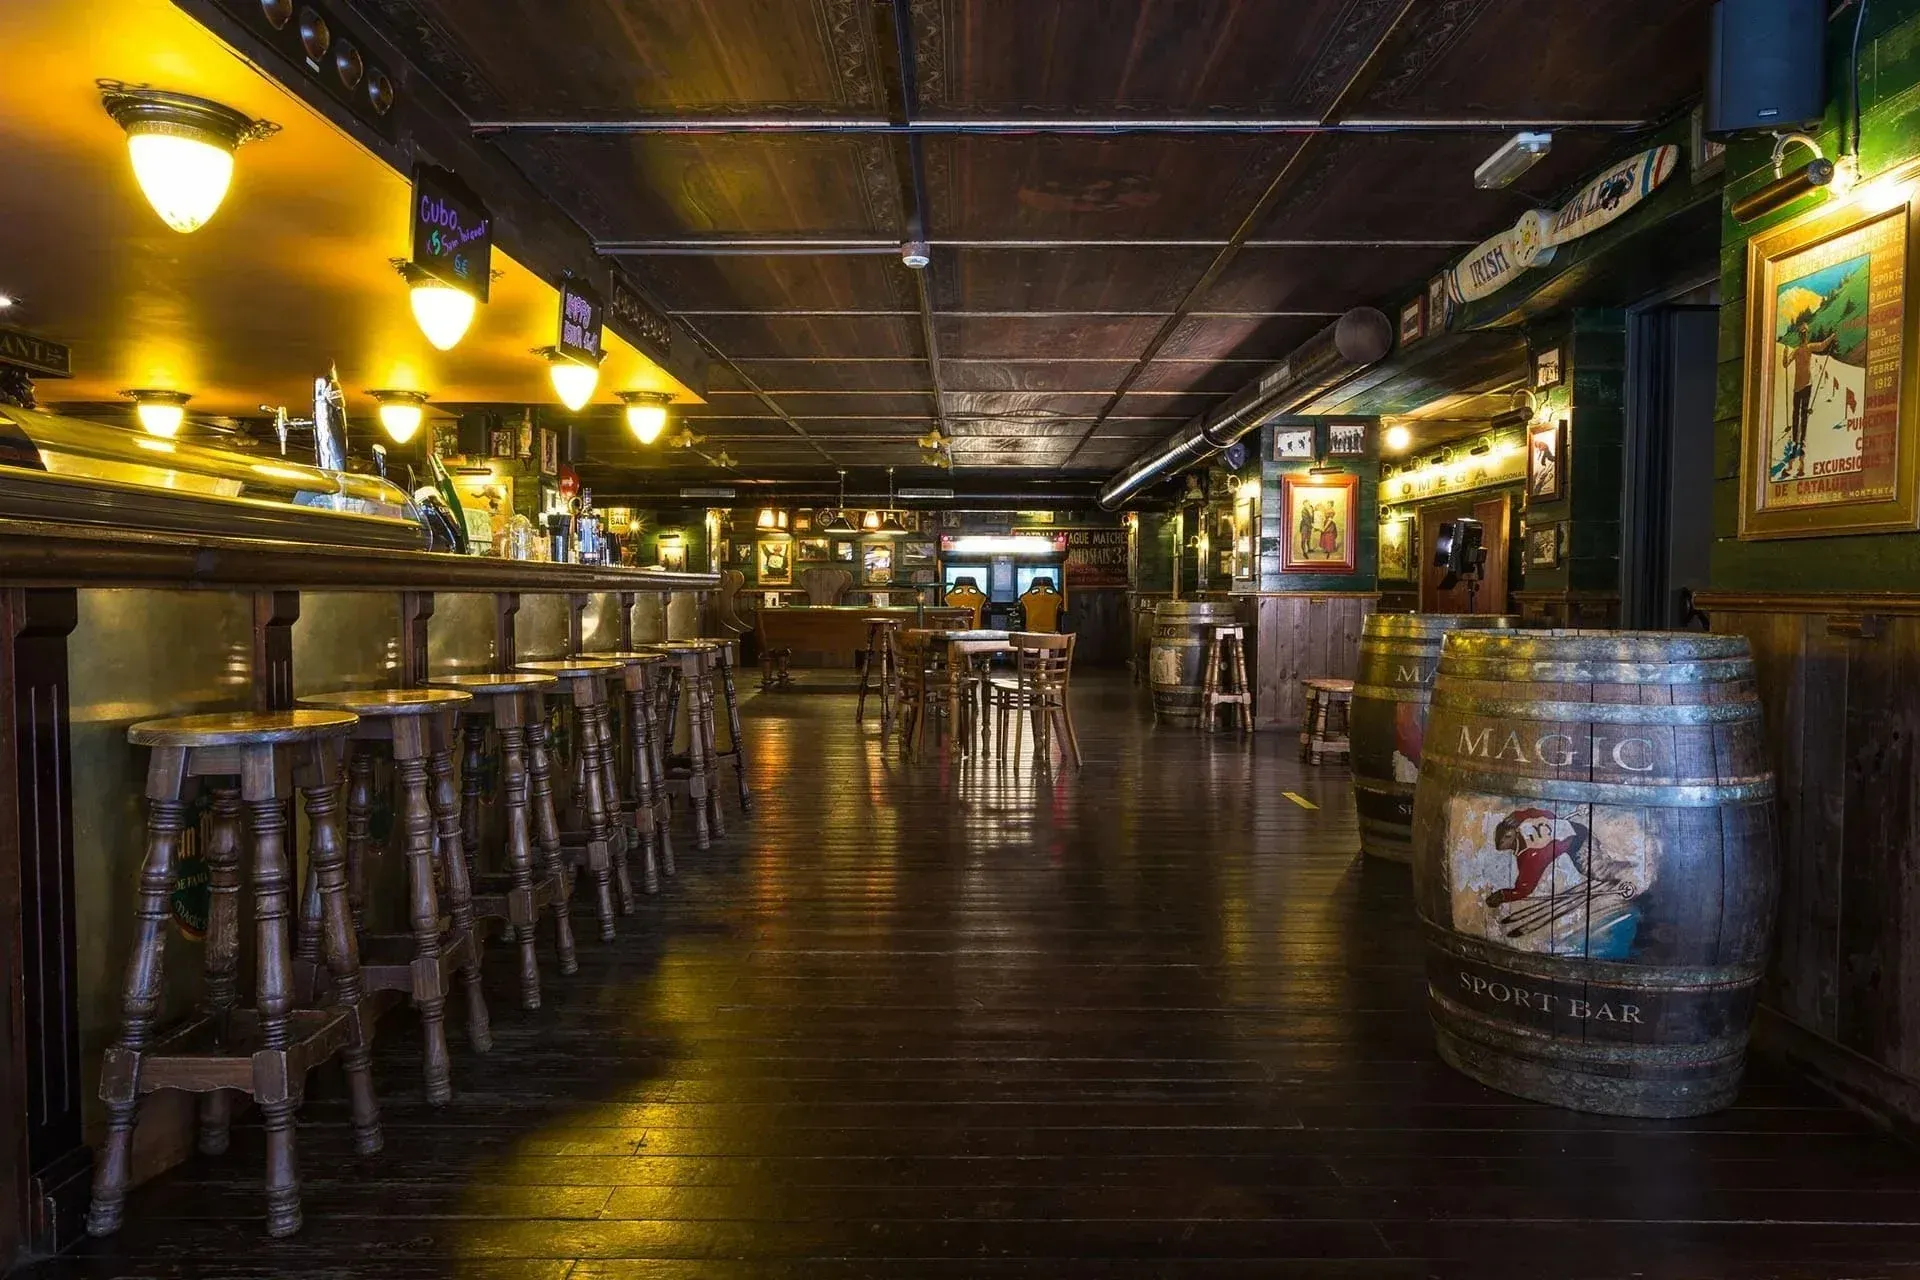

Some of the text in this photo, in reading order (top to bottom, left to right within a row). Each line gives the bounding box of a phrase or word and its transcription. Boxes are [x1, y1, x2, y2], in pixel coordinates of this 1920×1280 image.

[421, 195, 458, 231] Cubo
[1469, 245, 1511, 288] IRISH
[1874, 376, 1893, 391] 1912
[1402, 467, 1488, 495] OMEGA
[1775, 483, 1789, 497] DE
[1063, 532, 1089, 545] AGUE
[1456, 725, 1654, 772] MAGIC
[1459, 971, 1645, 1025] SPORT BAR
